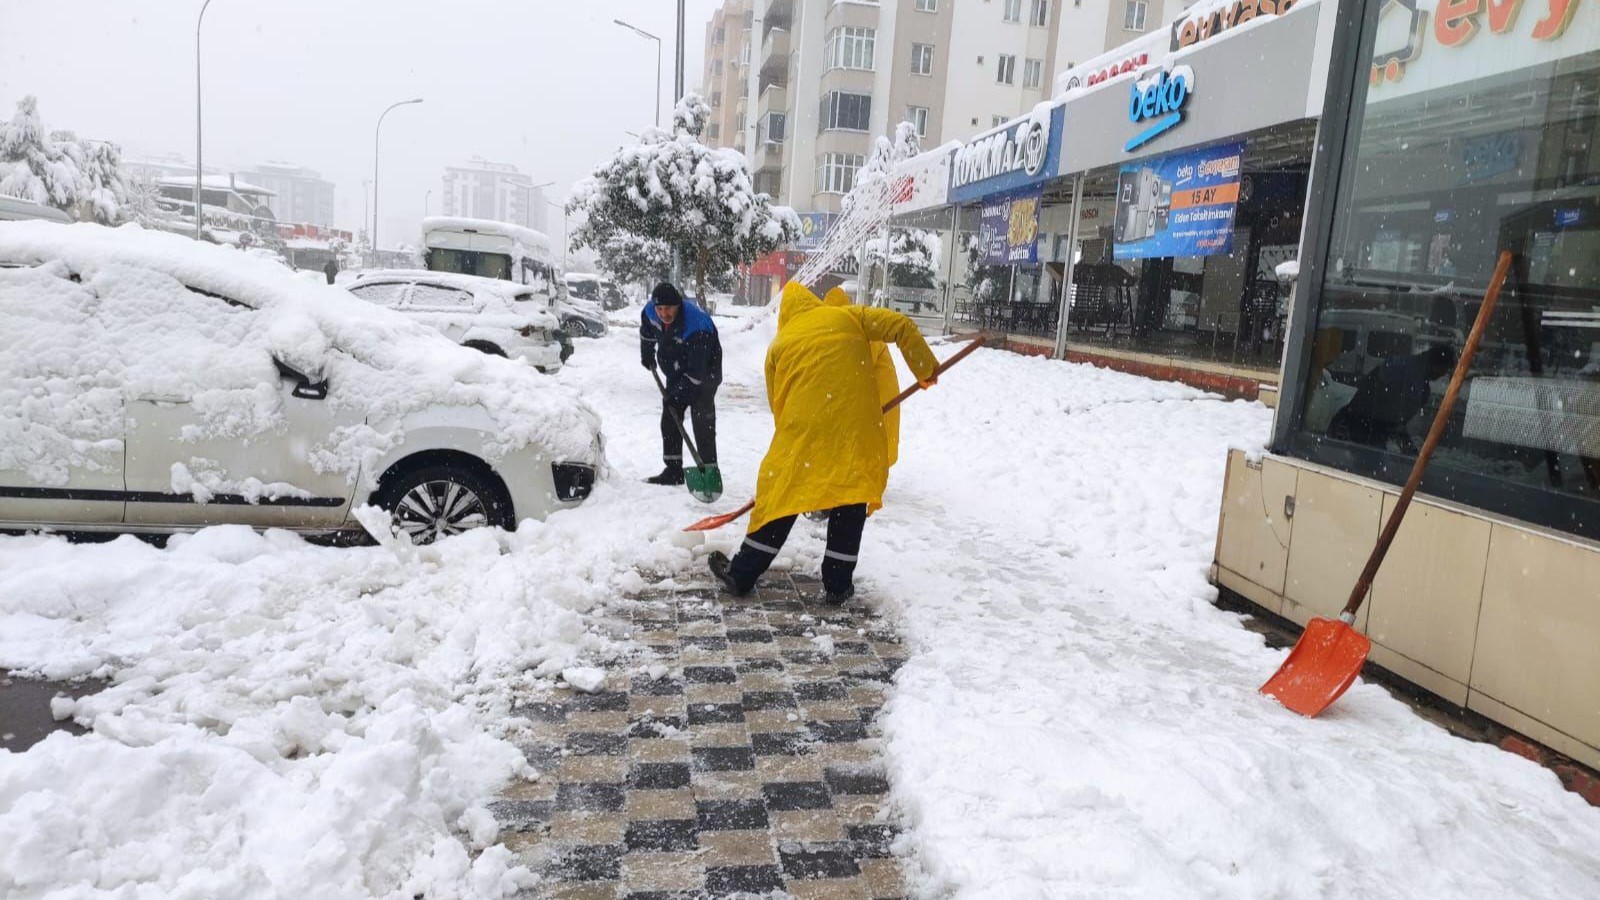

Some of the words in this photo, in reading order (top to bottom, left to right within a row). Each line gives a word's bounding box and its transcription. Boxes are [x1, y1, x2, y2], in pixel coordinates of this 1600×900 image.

[1129, 71, 1187, 123] beko
[1191, 190, 1202, 204] 15
[1203, 188, 1217, 202] AY
